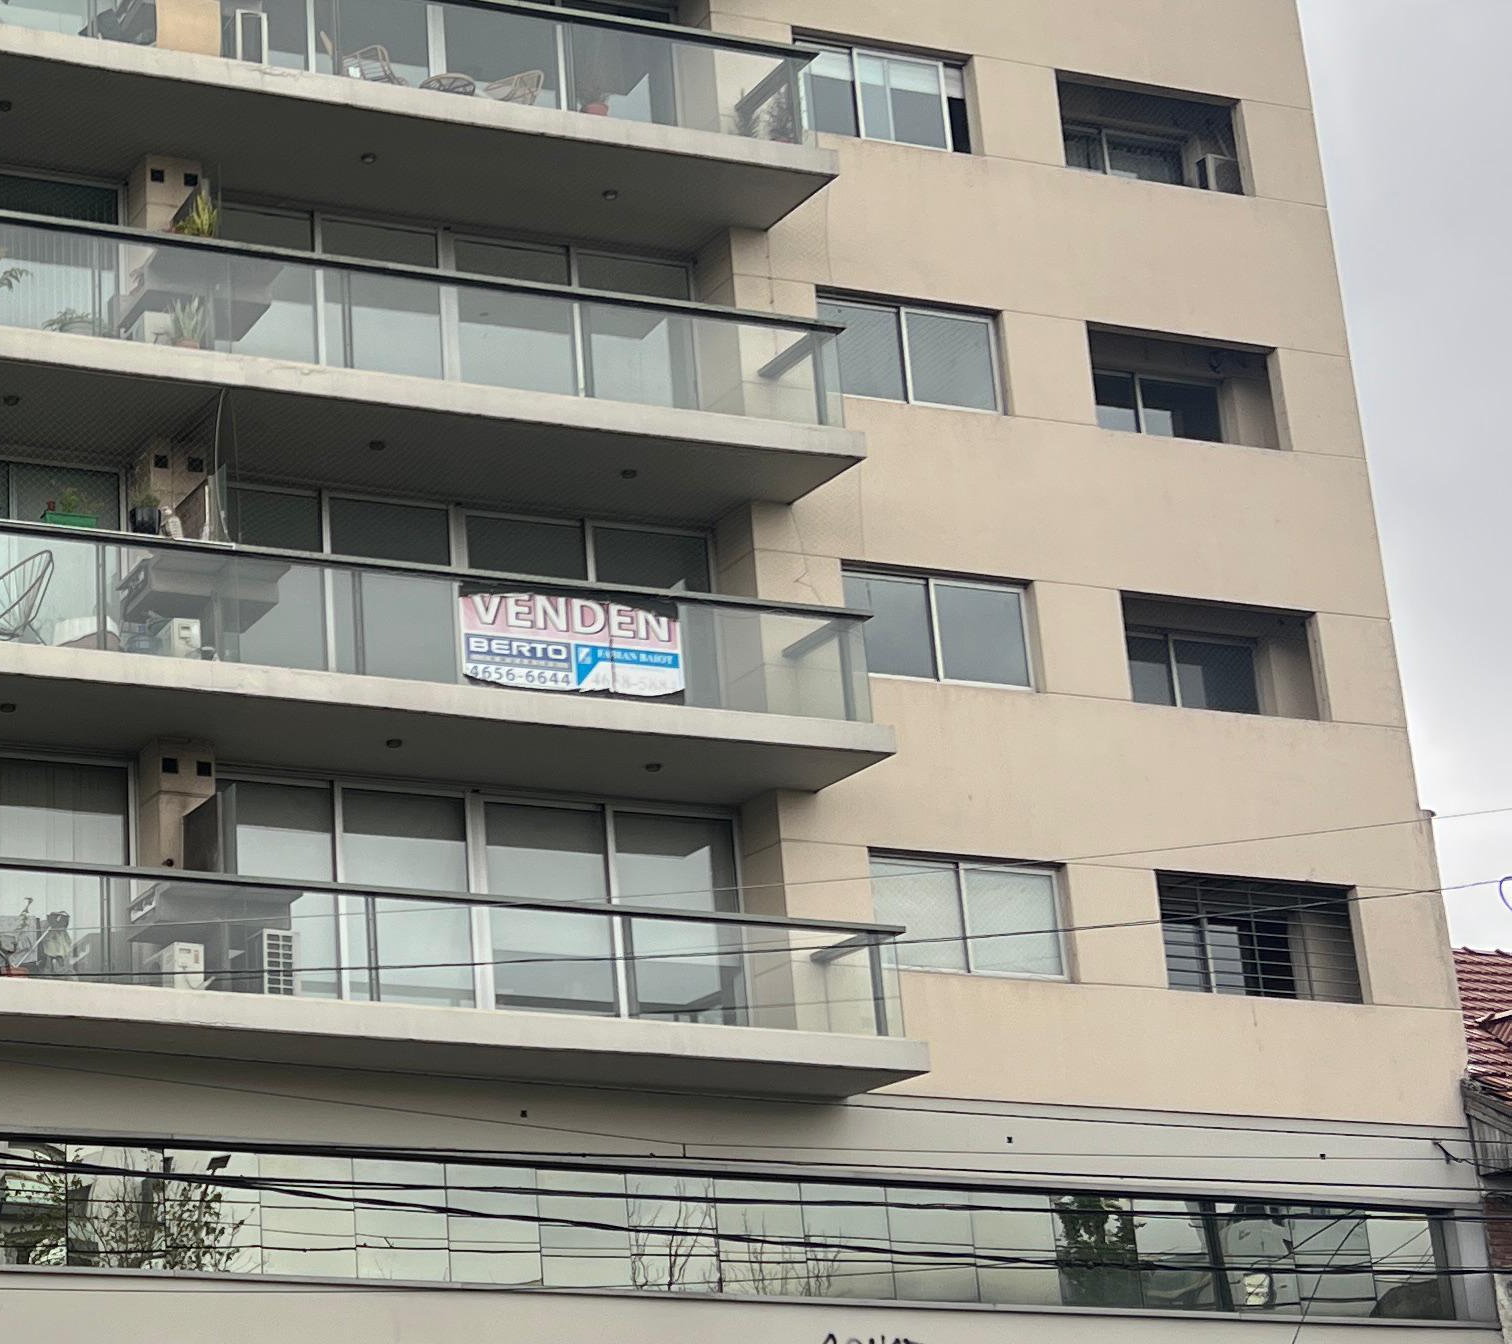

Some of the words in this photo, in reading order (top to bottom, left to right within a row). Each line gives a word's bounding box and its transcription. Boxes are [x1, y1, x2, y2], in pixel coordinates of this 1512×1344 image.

[471, 594, 672, 642] VENDEN
[468, 637, 567, 659] BERTO
[470, 665, 570, 686] 4656-6644
